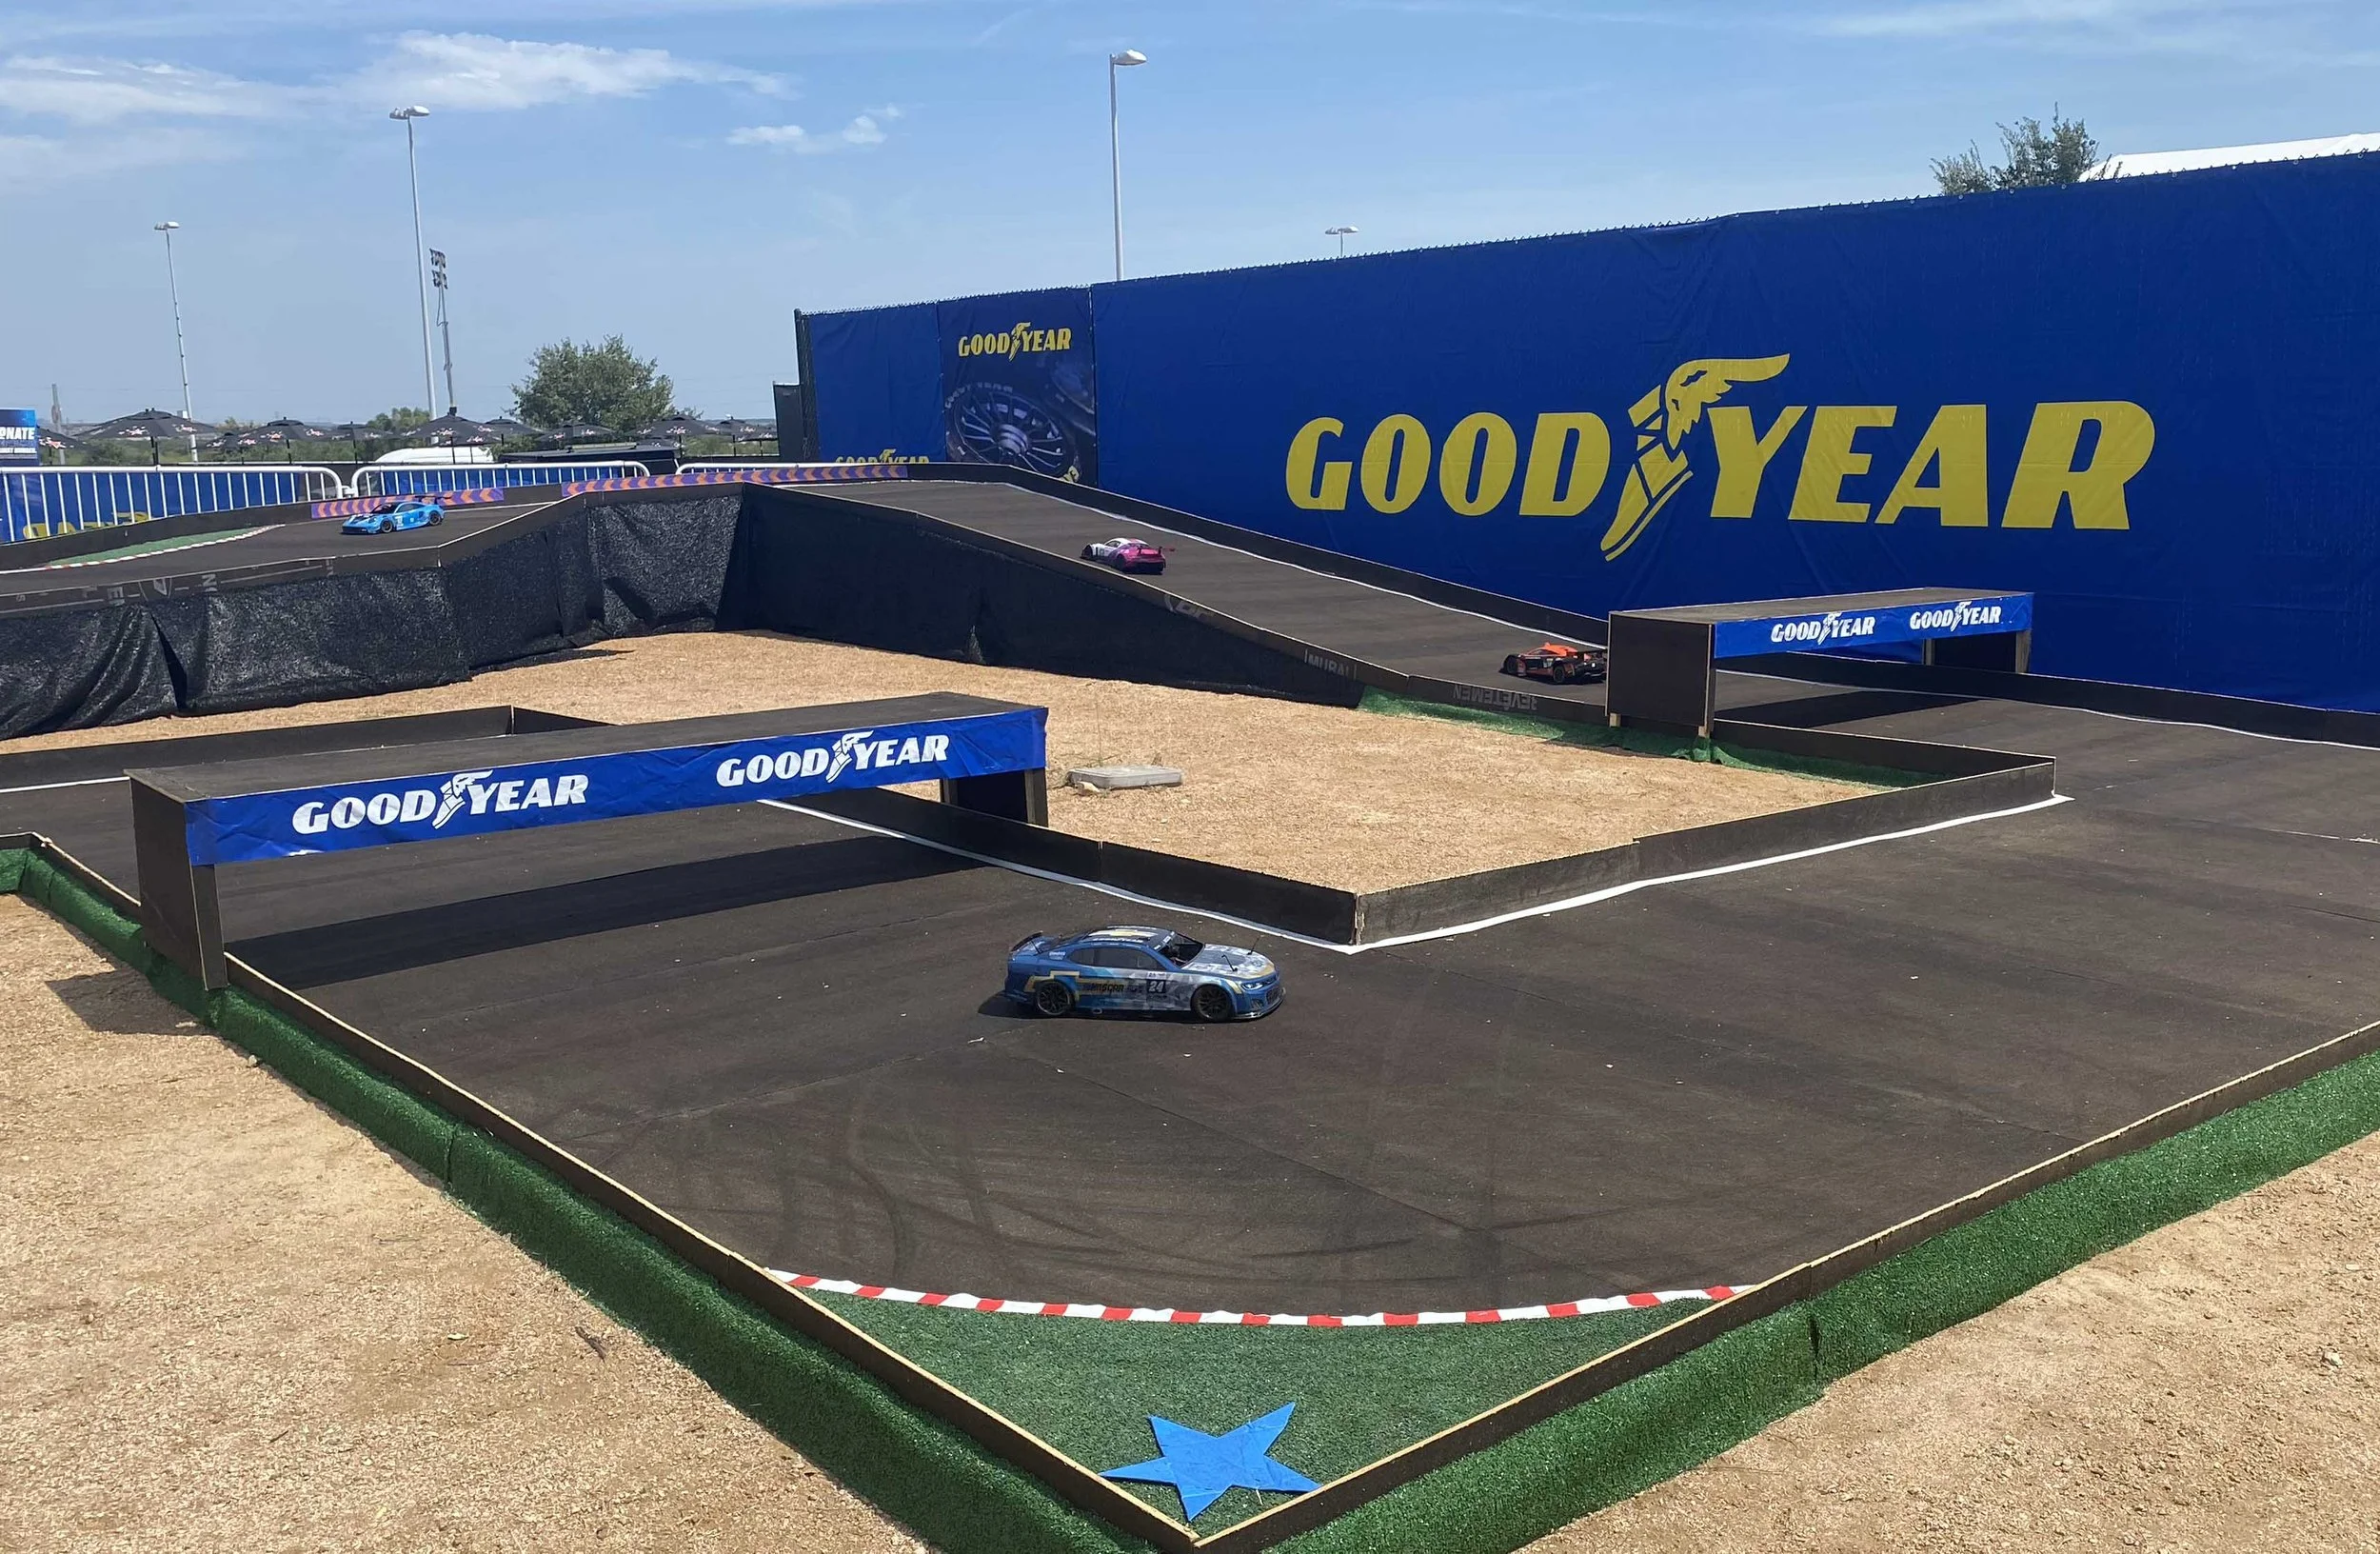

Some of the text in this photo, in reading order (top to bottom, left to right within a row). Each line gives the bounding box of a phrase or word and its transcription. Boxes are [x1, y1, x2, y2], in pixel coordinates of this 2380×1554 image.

[958, 328, 1072, 357] GOODYEAR
[1286, 401, 2156, 531] GOODYEAR
[1770, 615, 1875, 644] GOODYEAR
[1910, 606, 2002, 630] GOODYEAR
[716, 734, 950, 787] GOODYEAR
[291, 774, 589, 835] GOODYEAR
[1148, 980, 1164, 993] 24
